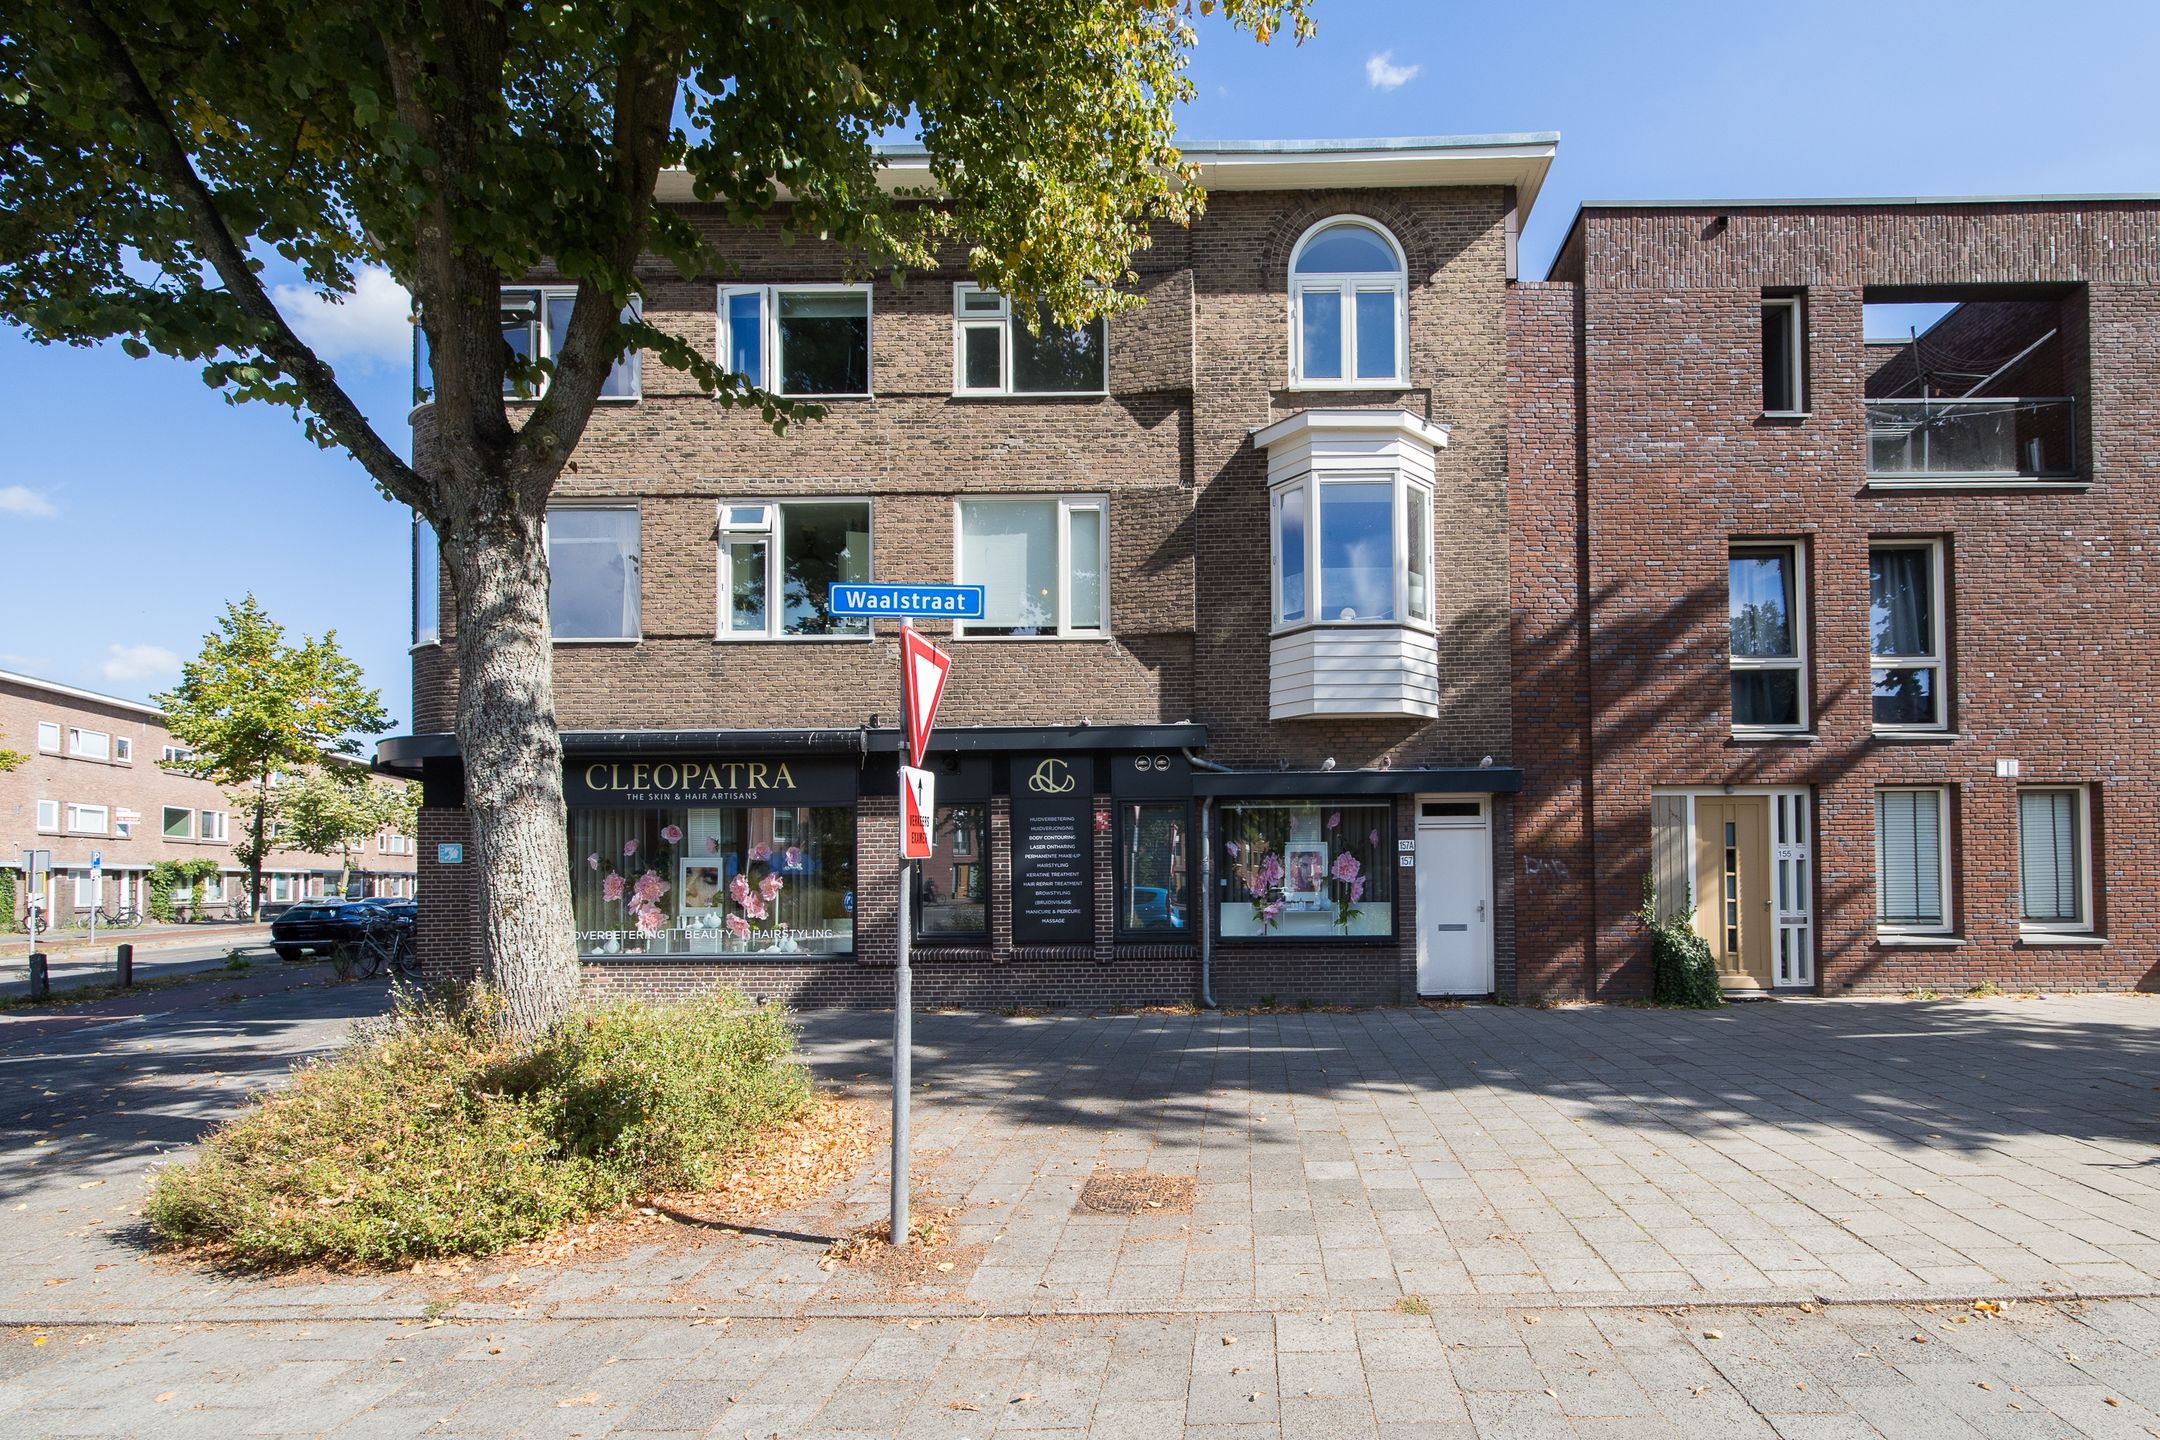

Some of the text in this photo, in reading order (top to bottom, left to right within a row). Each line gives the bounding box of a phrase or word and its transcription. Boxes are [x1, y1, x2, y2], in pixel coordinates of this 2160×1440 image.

[845, 591, 966, 610] Waalstraat
[585, 762, 797, 791] CLEOPATRA
[685, 792, 708, 800] HAIR
[1399, 841, 1414, 850] 157A
[94, 852, 100, 862] P
[1778, 850, 1792, 858] 155
[1401, 856, 1413, 866] 157
[684, 928, 734, 939] BEAUTY
[752, 928, 834, 939] HAIRSTYLING
